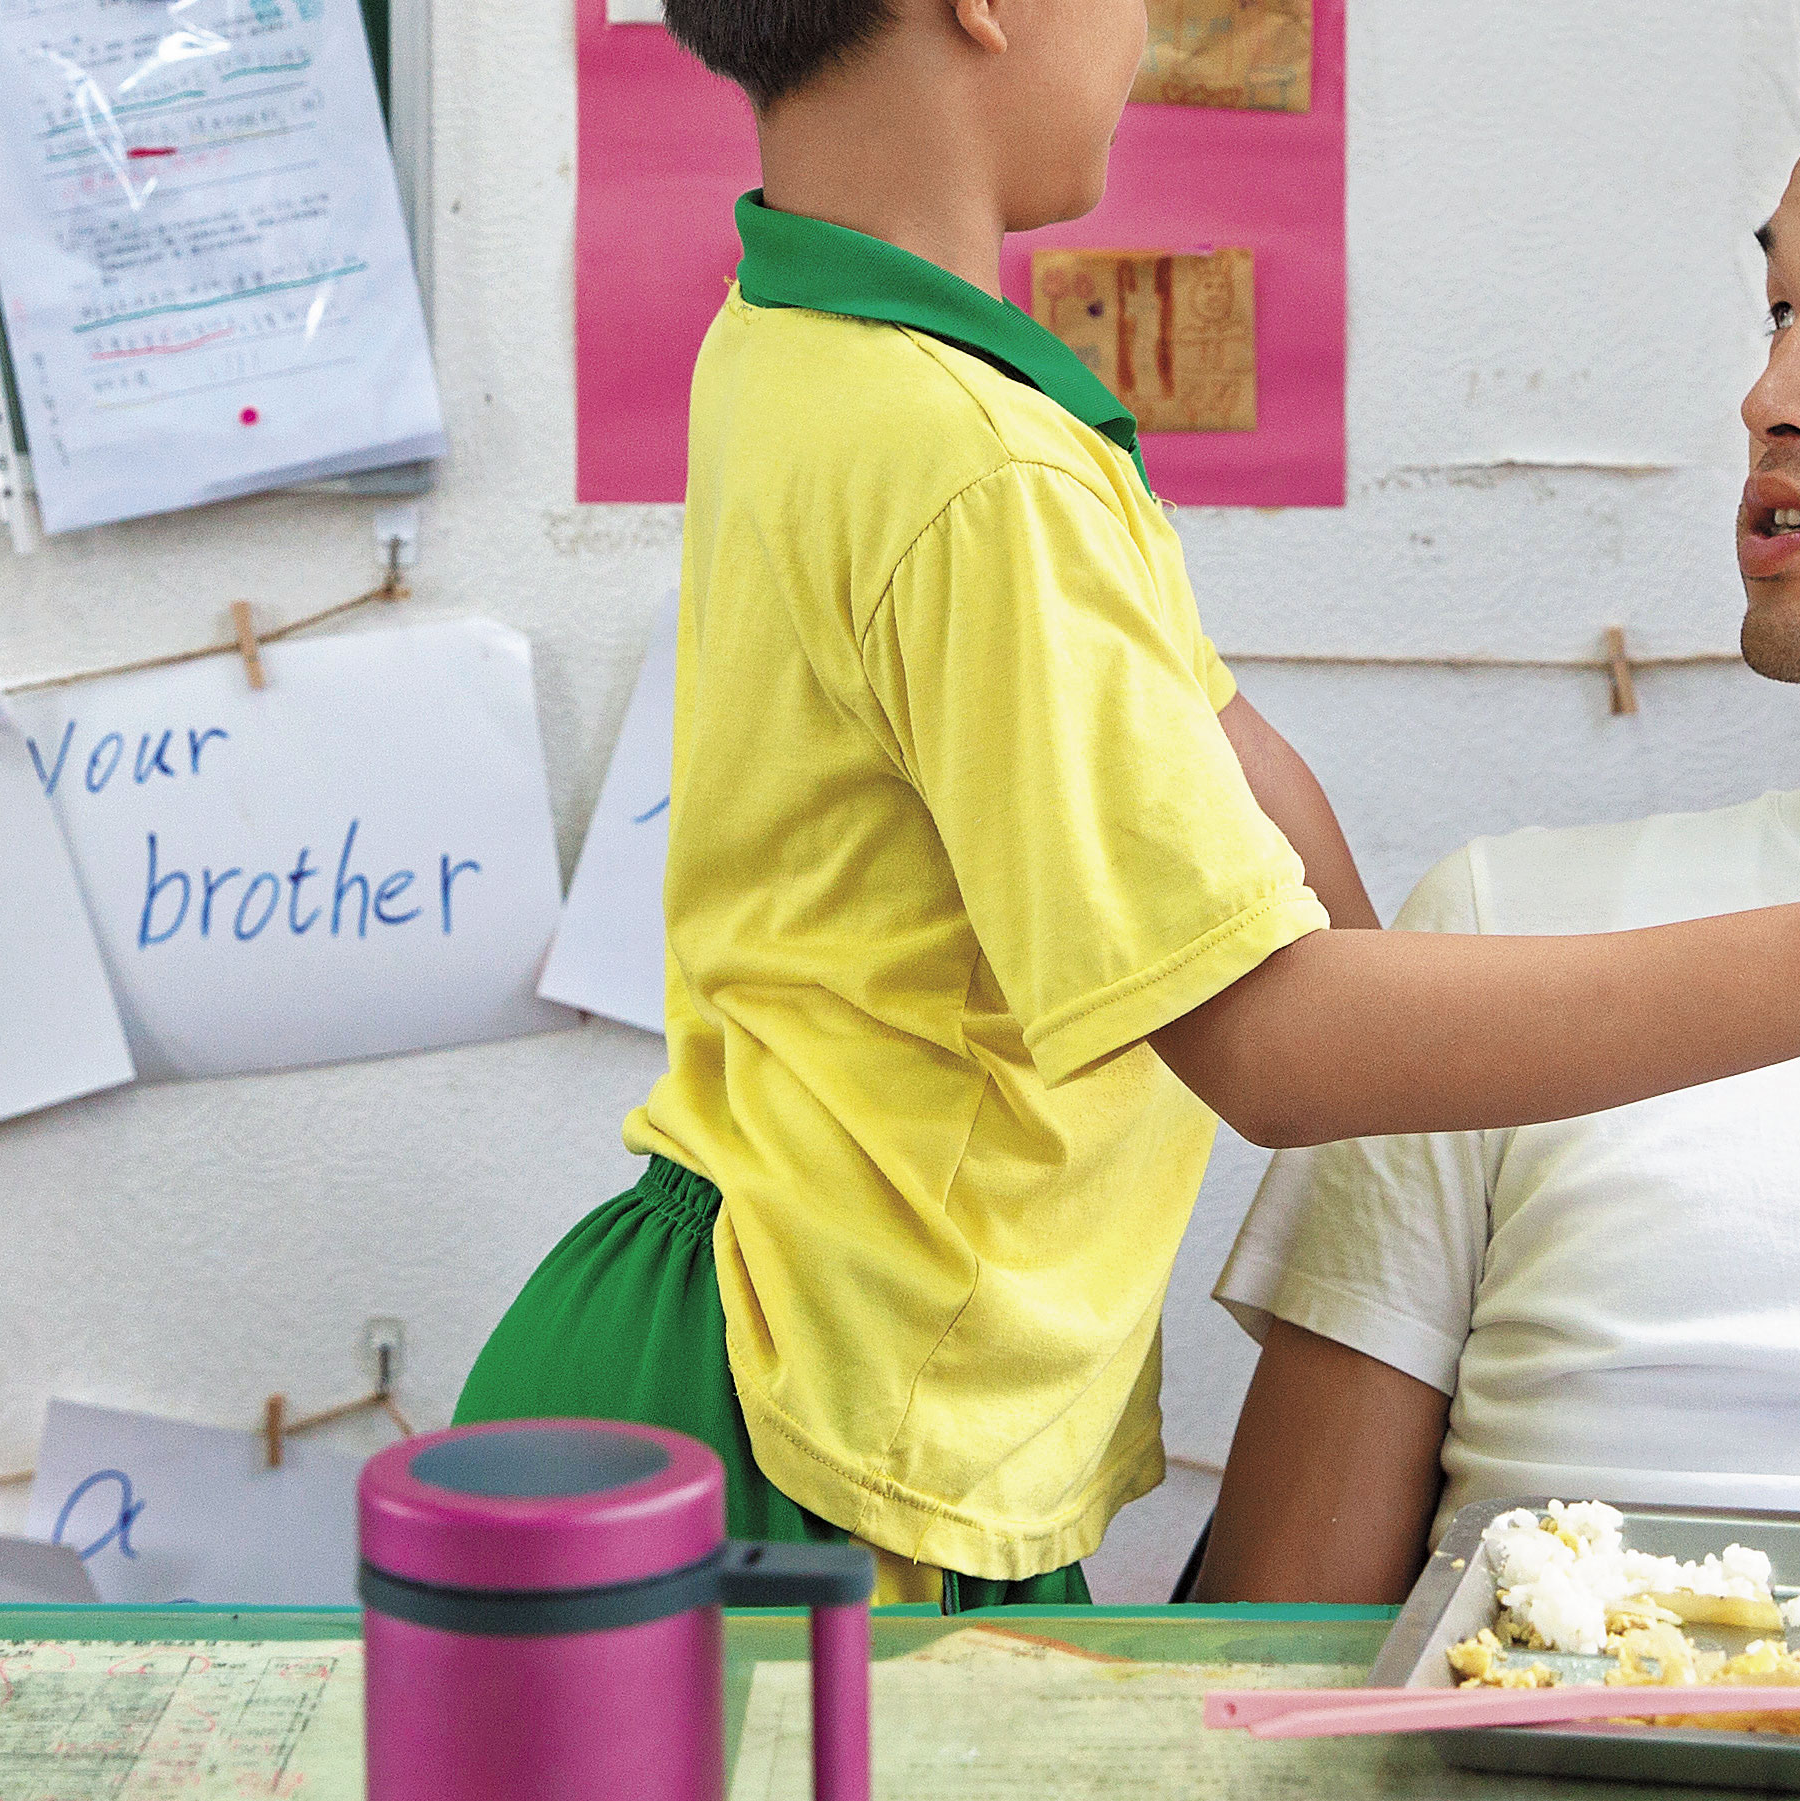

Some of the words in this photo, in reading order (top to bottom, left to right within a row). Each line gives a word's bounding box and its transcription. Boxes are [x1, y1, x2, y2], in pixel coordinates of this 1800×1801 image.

[25, 718, 230, 798] your
[135, 816, 484, 953] brother
[50, 1466, 144, 1562] a
